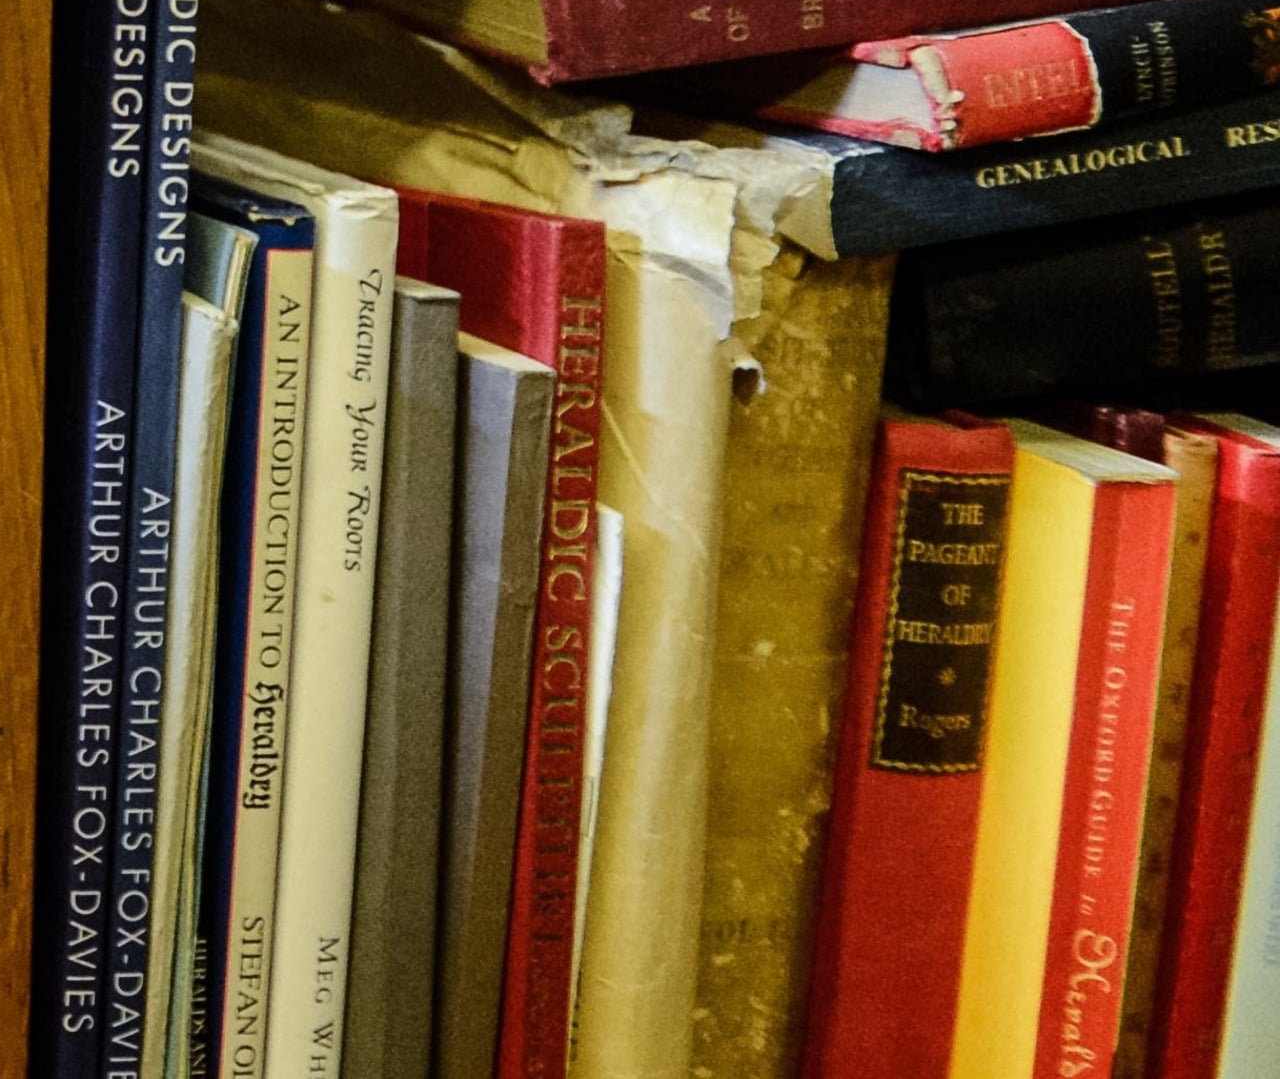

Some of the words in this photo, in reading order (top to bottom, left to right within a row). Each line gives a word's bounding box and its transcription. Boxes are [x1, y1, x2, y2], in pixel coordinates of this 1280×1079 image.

[689, 5, 713, 22] A
[727, 7, 751, 43] OF
[154, 81, 195, 267] DESIGNS
[975, 135, 1192, 190] GENEALOGICAL
[279, 294, 302, 343] AN
[88, 400, 126, 564] ARTHUR
[263, 356, 299, 614] INTRODUCTION
[546, 294, 602, 603] HERALDIC
[132, 487, 171, 650] ARTHUR
[942, 503, 985, 526] THE
[260, 623, 284, 669] TO
[943, 584, 972, 606] OF
[75, 581, 119, 768] CHARLES
[898, 704, 972, 738] Rogers
[120, 666, 162, 852] CHARLES
[243, 681, 284, 811] Heraldry
[61, 786, 107, 1034] FOX-DAVIES
[234, 917, 264, 1037] STEFAN
